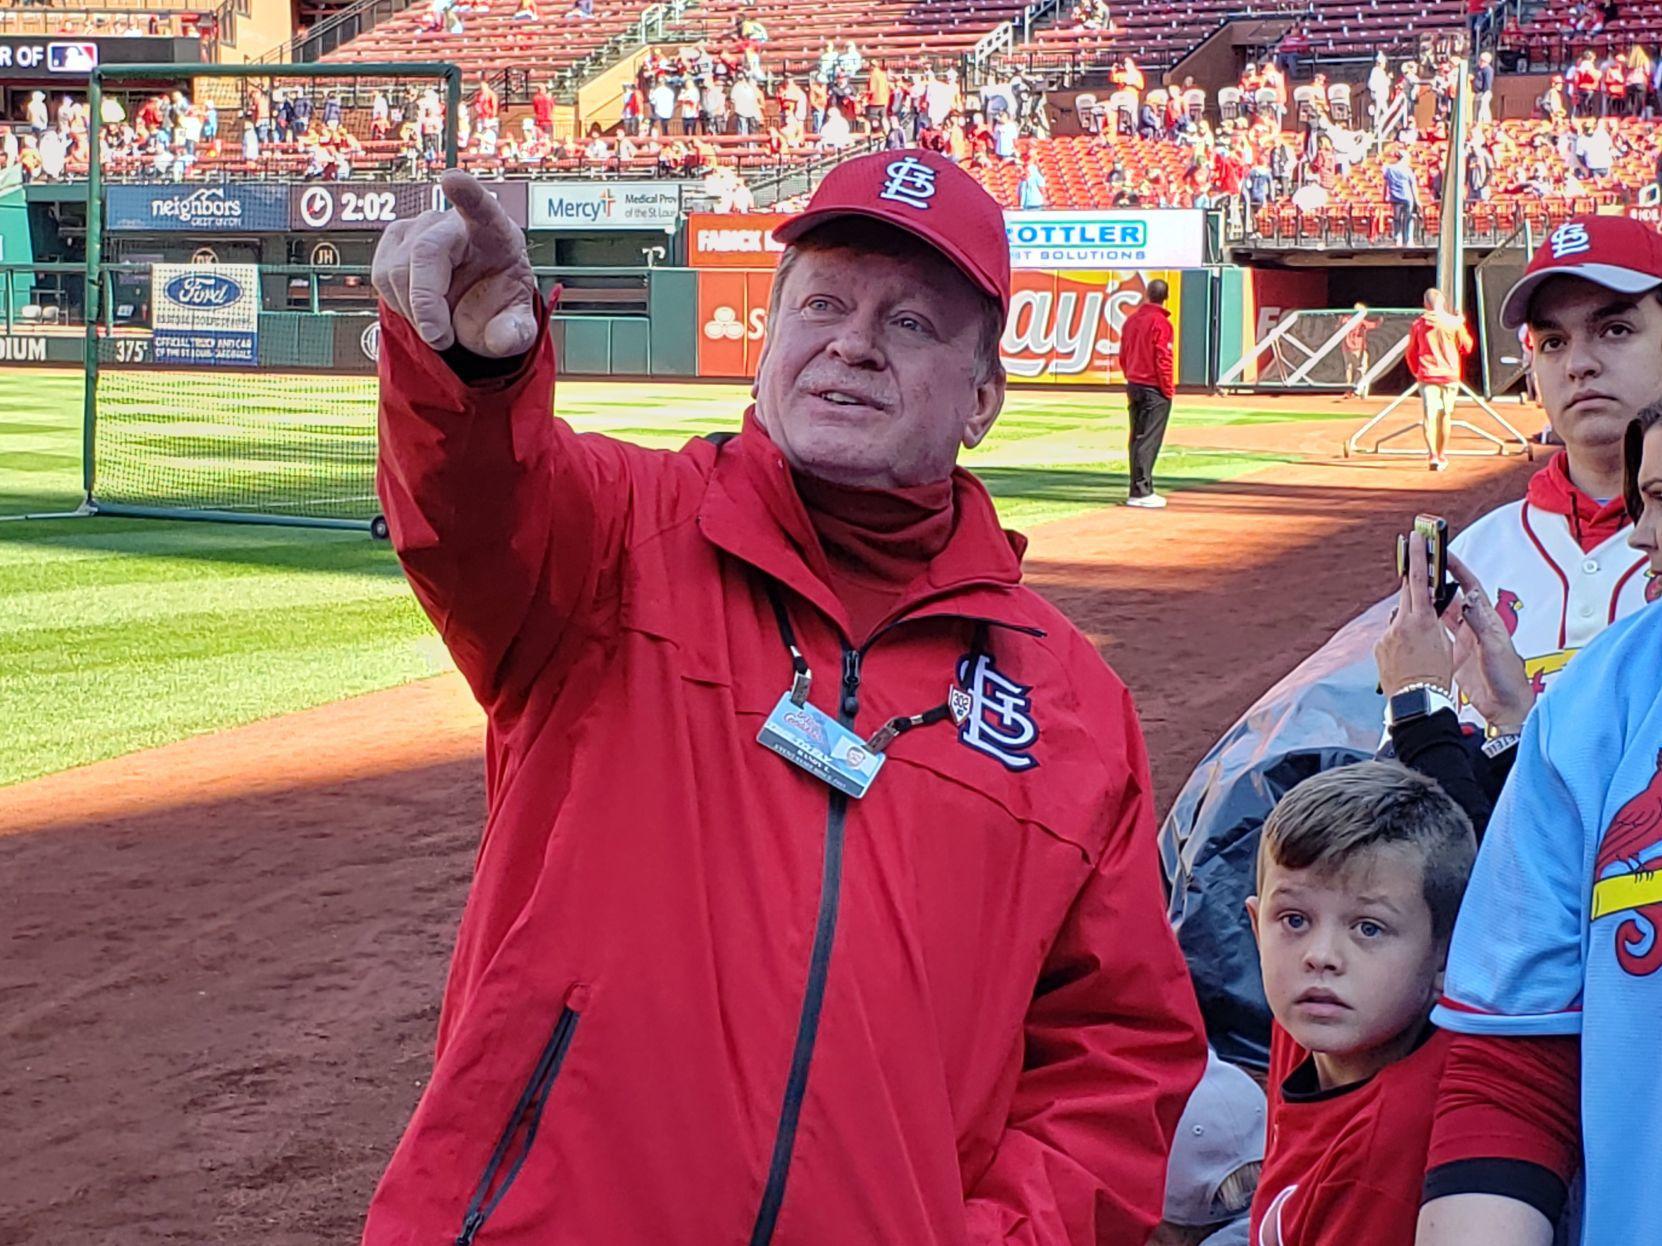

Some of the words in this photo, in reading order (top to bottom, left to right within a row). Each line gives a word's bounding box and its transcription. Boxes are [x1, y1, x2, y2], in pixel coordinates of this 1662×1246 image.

[16, 46, 45, 67] OF
[152, 193, 242, 220] neighbors
[341, 192, 397, 221] 2:02
[547, 199, 600, 222] Mercy
[625, 194, 657, 204] Medical
[1040, 250, 1146, 260] SOLUTIONS
[178, 278, 229, 304] Ford
